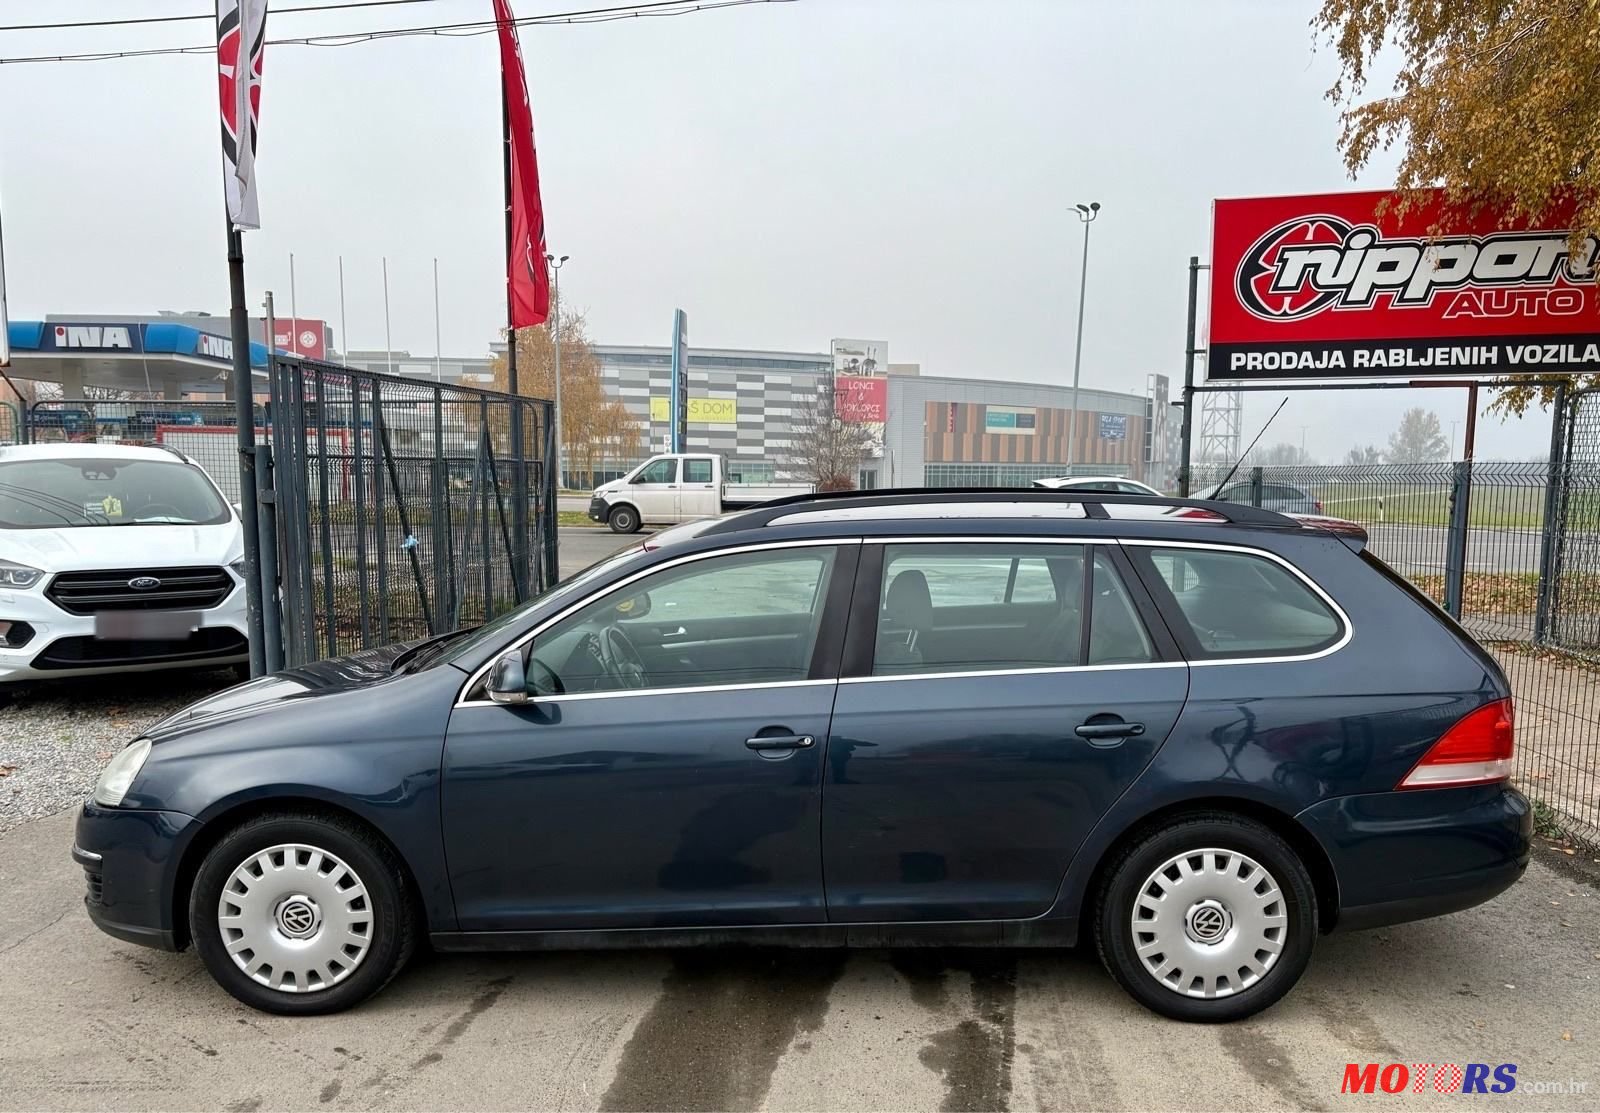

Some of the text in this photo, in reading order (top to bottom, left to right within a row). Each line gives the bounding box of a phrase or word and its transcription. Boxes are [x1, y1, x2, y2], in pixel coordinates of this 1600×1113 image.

[1275, 227, 1596, 304] nippon
[1442, 288, 1584, 318] AUTO
[1230, 343, 1600, 371] PRODAJA RABLJENIH VOZILA
[703, 402, 732, 414] DOM
